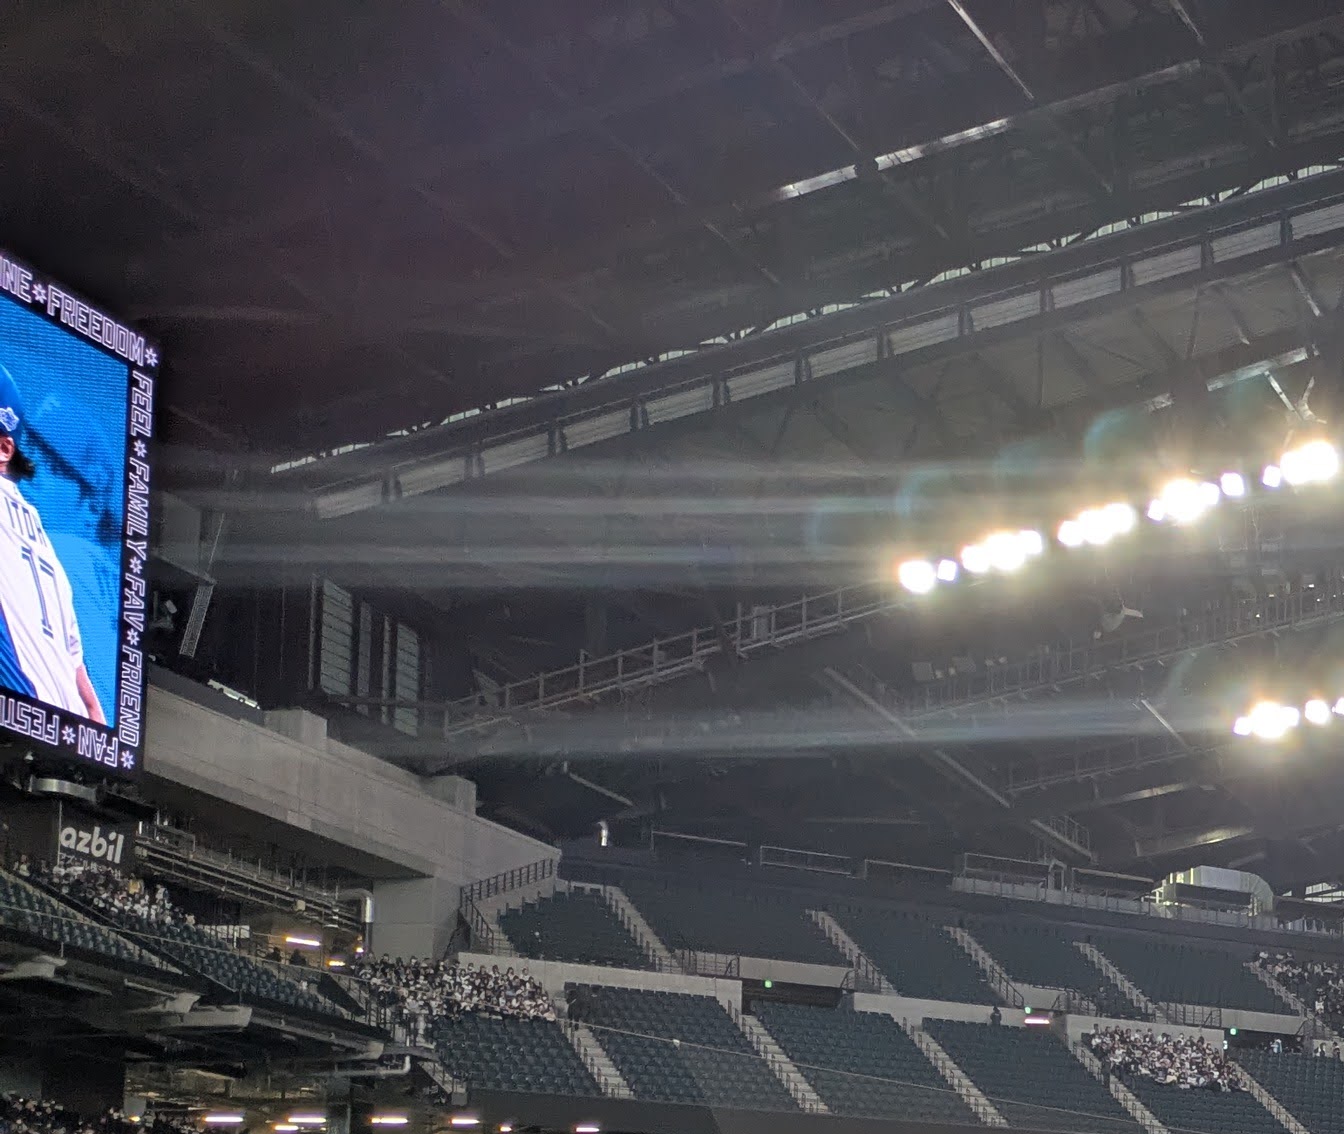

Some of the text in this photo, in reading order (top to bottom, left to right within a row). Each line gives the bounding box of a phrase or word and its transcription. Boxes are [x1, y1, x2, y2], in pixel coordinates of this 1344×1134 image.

[47, 284, 146, 367] FREEDOM
[130, 370, 153, 437] FEEL
[126, 457, 150, 560] FAMILY
[123, 573, 146, 632] FAV
[119, 645, 143, 747] FRIEND
[77, 723, 119, 768] FAN
[60, 826, 124, 864] azbil
